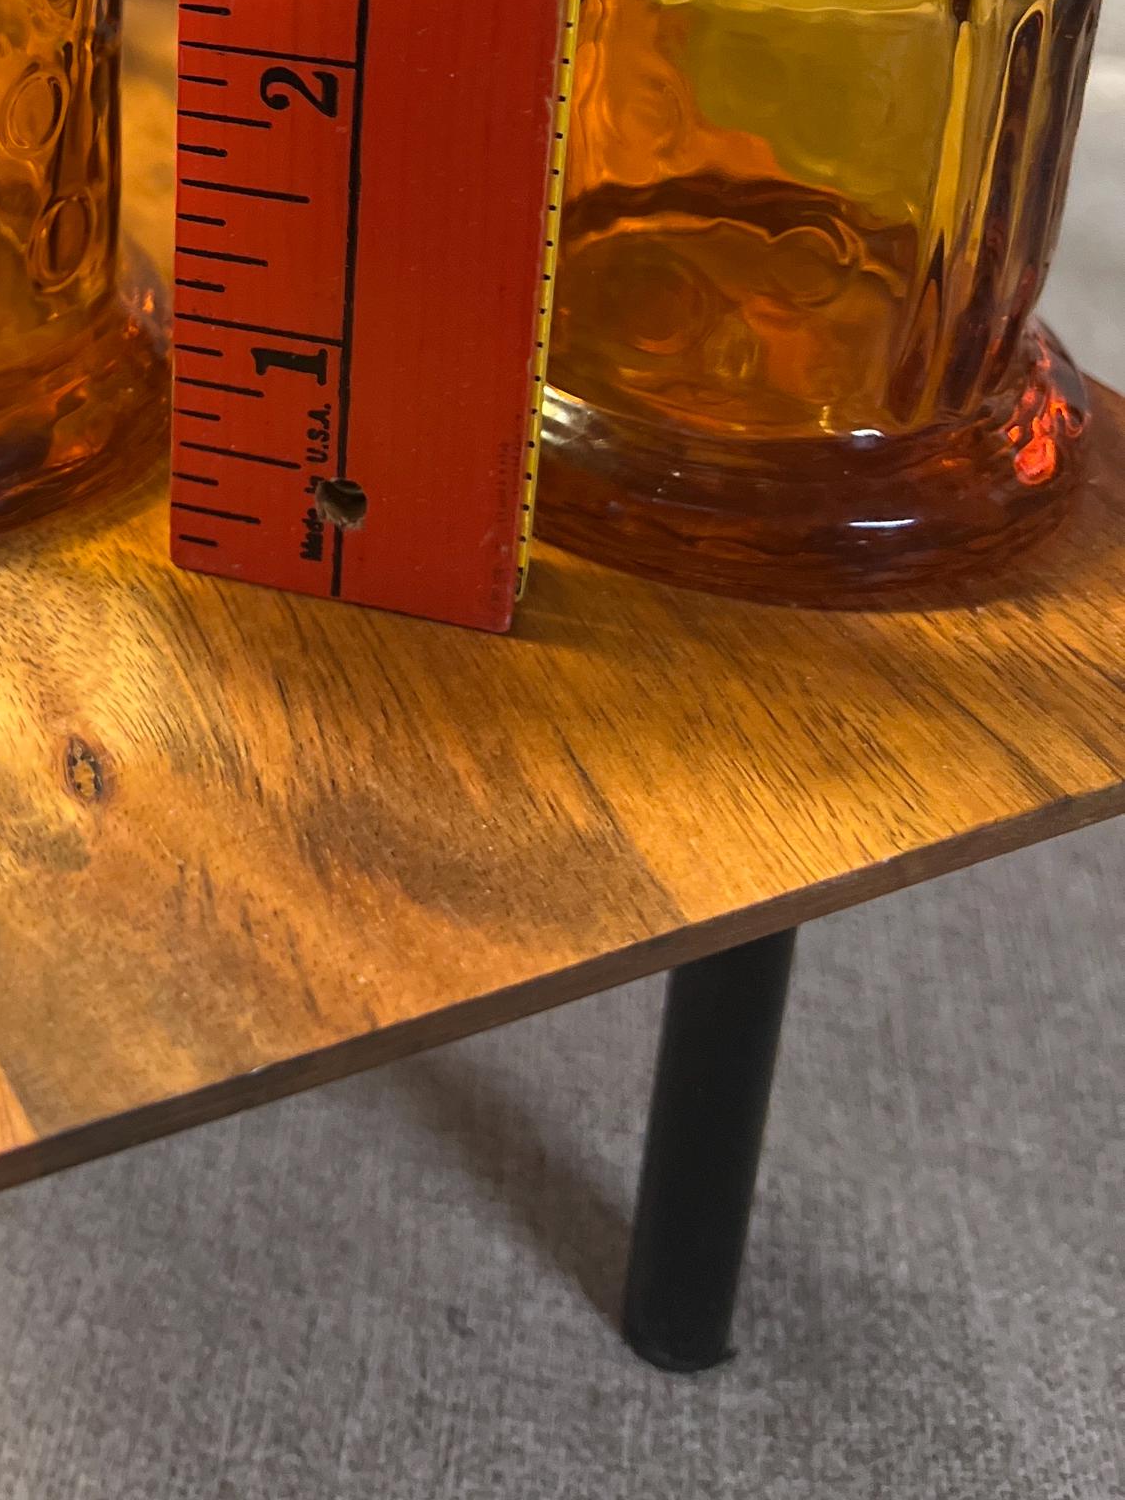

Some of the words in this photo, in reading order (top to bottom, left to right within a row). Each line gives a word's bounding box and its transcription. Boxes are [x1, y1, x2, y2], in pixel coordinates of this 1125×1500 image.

[259, 65, 339, 119] 2
[250, 347, 328, 387] 1
[305, 403, 332, 464] U.S.A.
